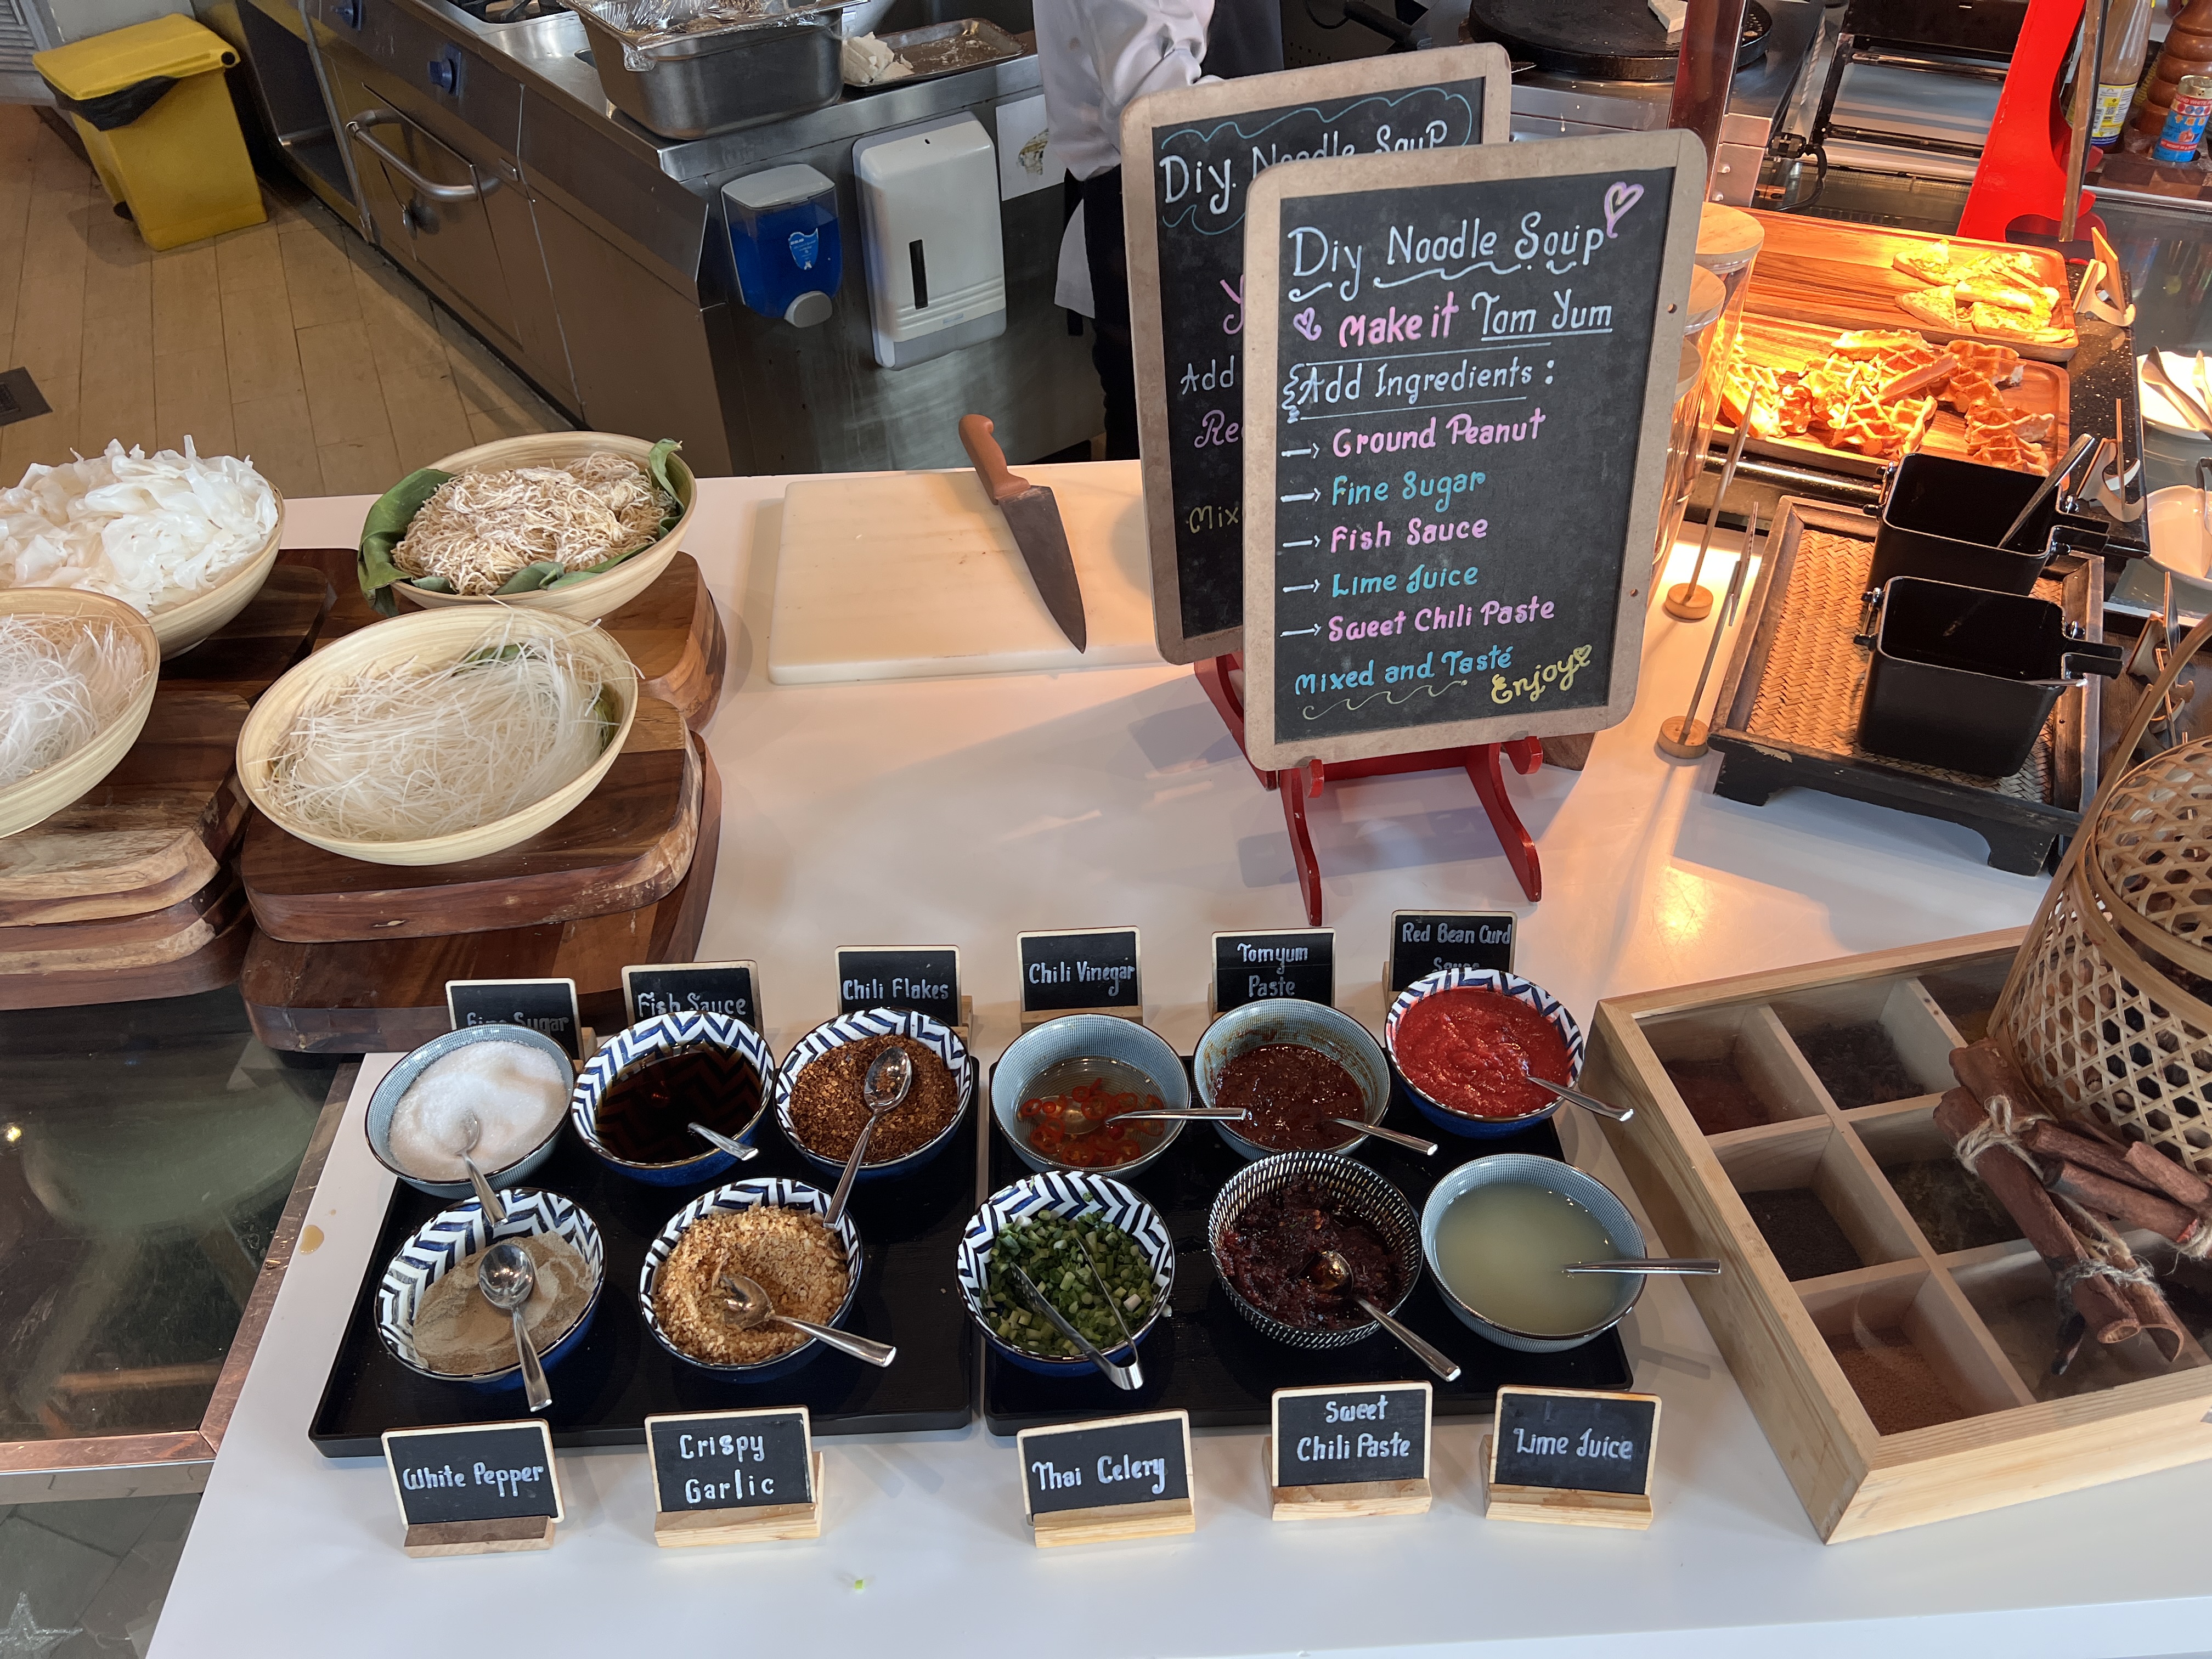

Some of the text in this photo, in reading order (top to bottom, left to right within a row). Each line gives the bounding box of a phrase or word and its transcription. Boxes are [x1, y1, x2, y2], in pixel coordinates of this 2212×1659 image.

[1288, 211, 1605, 301] Diy Noodle Soup
[1339, 288, 1612, 348] Make it Tom Yum
[1180, 354, 1235, 395] Add
[1297, 362, 1363, 405] Add
[1375, 356, 1533, 404] Ingredients
[1332, 407, 1547, 458] Ground Peanut
[1331, 470, 1486, 512] Fine Sugar
[1188, 505, 1239, 534] Mix
[1330, 517, 1488, 554] Fish Sauce
[1331, 564, 1479, 598] Lime Juice
[1328, 595, 1556, 642] Sweet Chili Paste
[1294, 659, 1375, 696] Mixed
[1384, 651, 1436, 685] and
[1491, 653, 1581, 705] Enjoy
[1402, 922, 1512, 945] Red Bean Curd
[842, 977, 949, 1001] Chili Flakes
[1029, 960, 1136, 997] Chili Vinegar
[1248, 974, 1296, 998] Paste
[637, 991, 747, 1018] Fish Sauce
[1325, 1393, 1389, 1424] Sweet
[679, 1434, 765, 1463] Crispy
[1296, 1431, 1411, 1462] Chili Paste
[1513, 1427, 1634, 1460] Lime Juice
[402, 1461, 544, 1498] White Pepper
[685, 1468, 775, 1504] Garlic
[1031, 1453, 1166, 1495] Thai Celery
